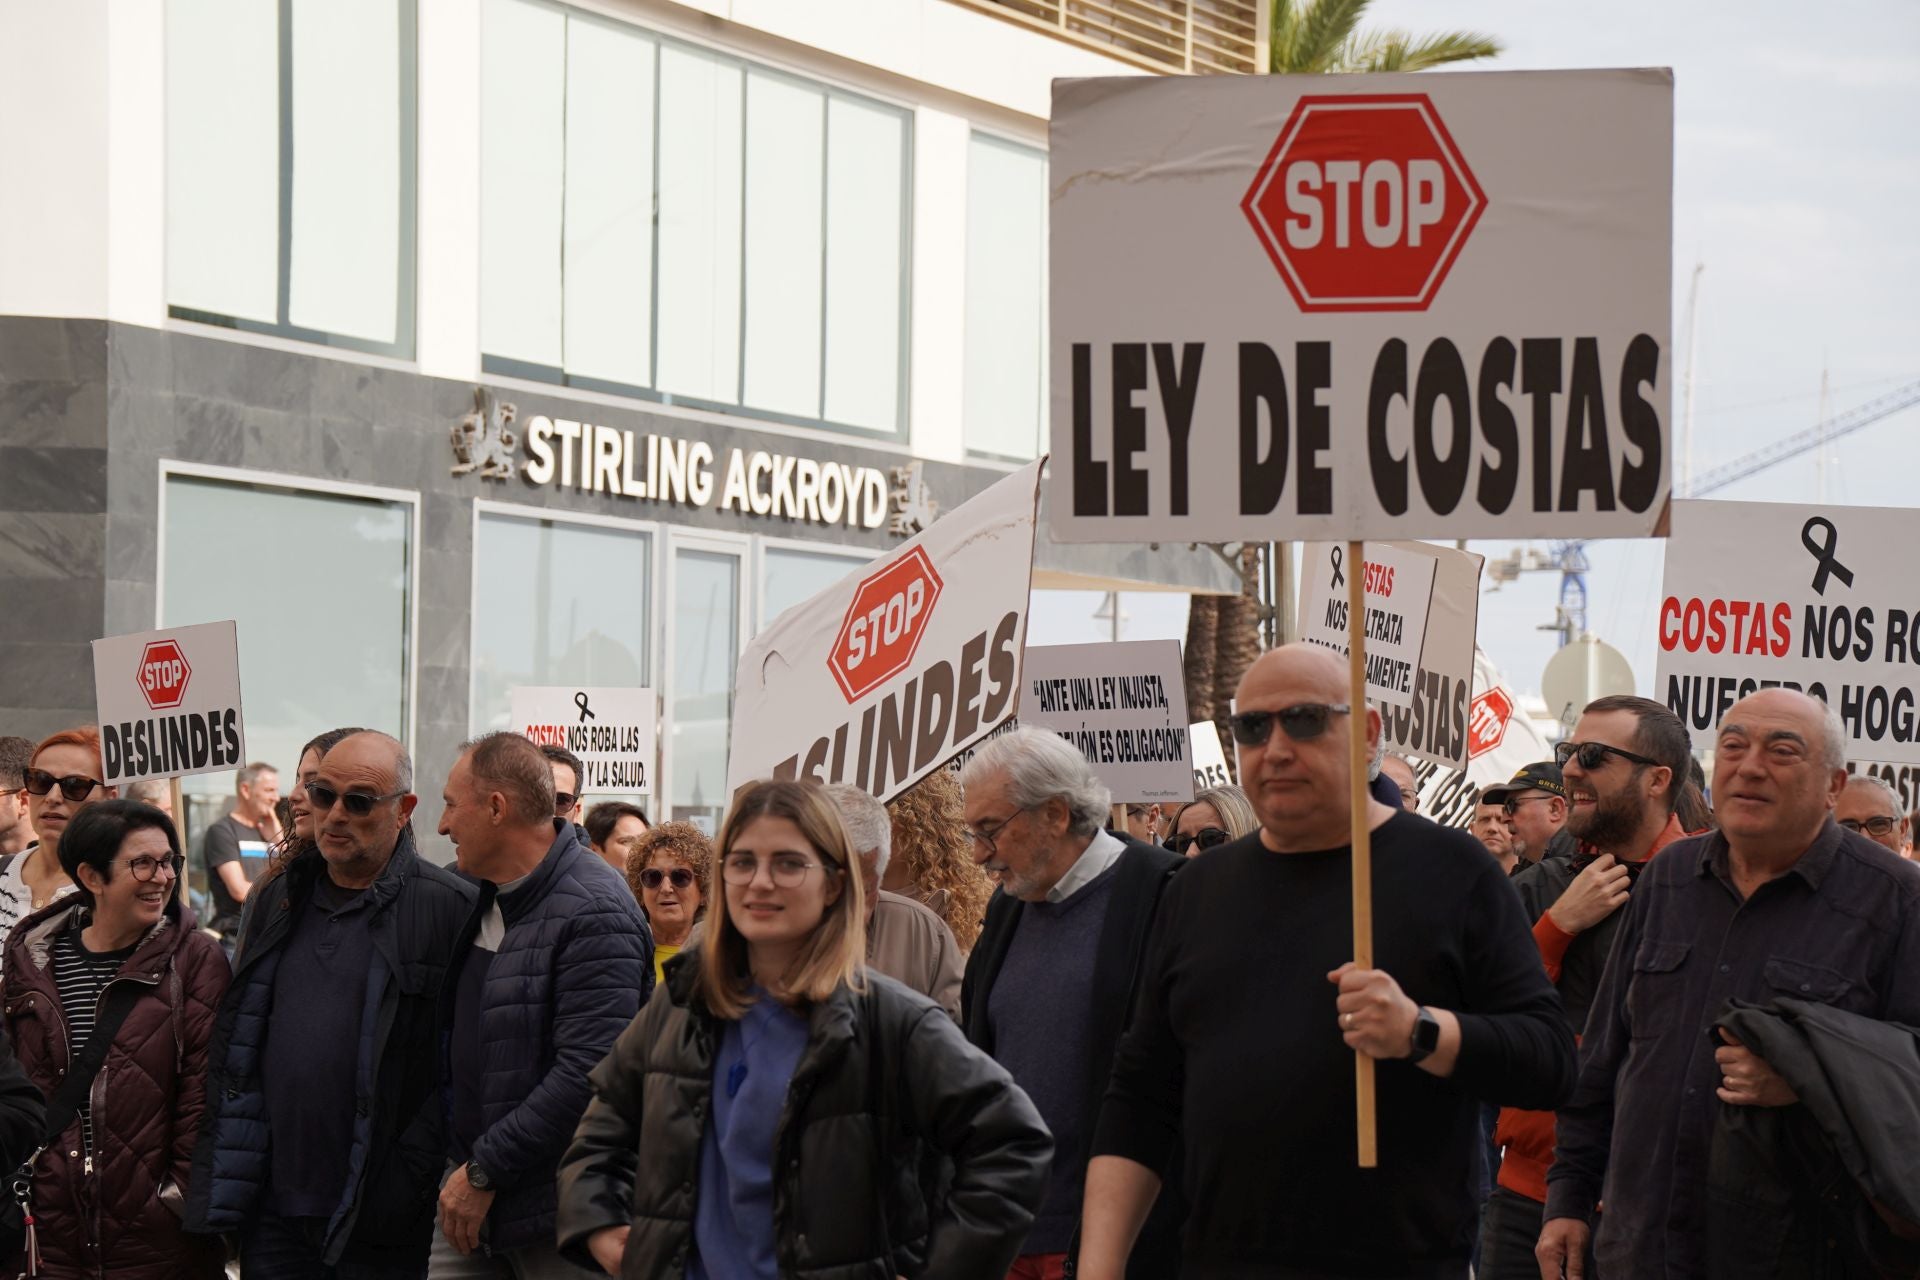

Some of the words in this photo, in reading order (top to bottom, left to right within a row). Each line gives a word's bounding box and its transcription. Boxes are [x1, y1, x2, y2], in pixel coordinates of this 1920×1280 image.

[1285, 159, 1446, 248] STOP
[1071, 342, 1205, 517] LEY
[1238, 341, 1333, 516] DE
[1368, 333, 1662, 517] COSTAS
[523, 415, 713, 506] STIRLING
[719, 448, 888, 529] ACKROYD
[847, 577, 925, 671] STOP
[1325, 598, 1349, 632] NOS
[1659, 596, 1792, 658] COSTAS
[1802, 604, 1875, 663] NOS
[145, 659, 182, 691] STOP
[732, 611, 1019, 798] INDES
[1071, 677, 1096, 711] UNA
[1096, 676, 1117, 710] LEY
[1119, 675, 1169, 714] INJUSTA,
[103, 708, 240, 780] DESLINDES
[526, 724, 565, 750] COSTAS
[567, 725, 588, 752] NOS
[590, 726, 617, 753] ROBA
[620, 726, 639, 753] LAS
[1841, 684, 1920, 743] HOG
[587, 761, 594, 787] Y
[596, 761, 608, 787] LA
[611, 761, 646, 788] SALUD.
[1099, 729, 1114, 763] ES
